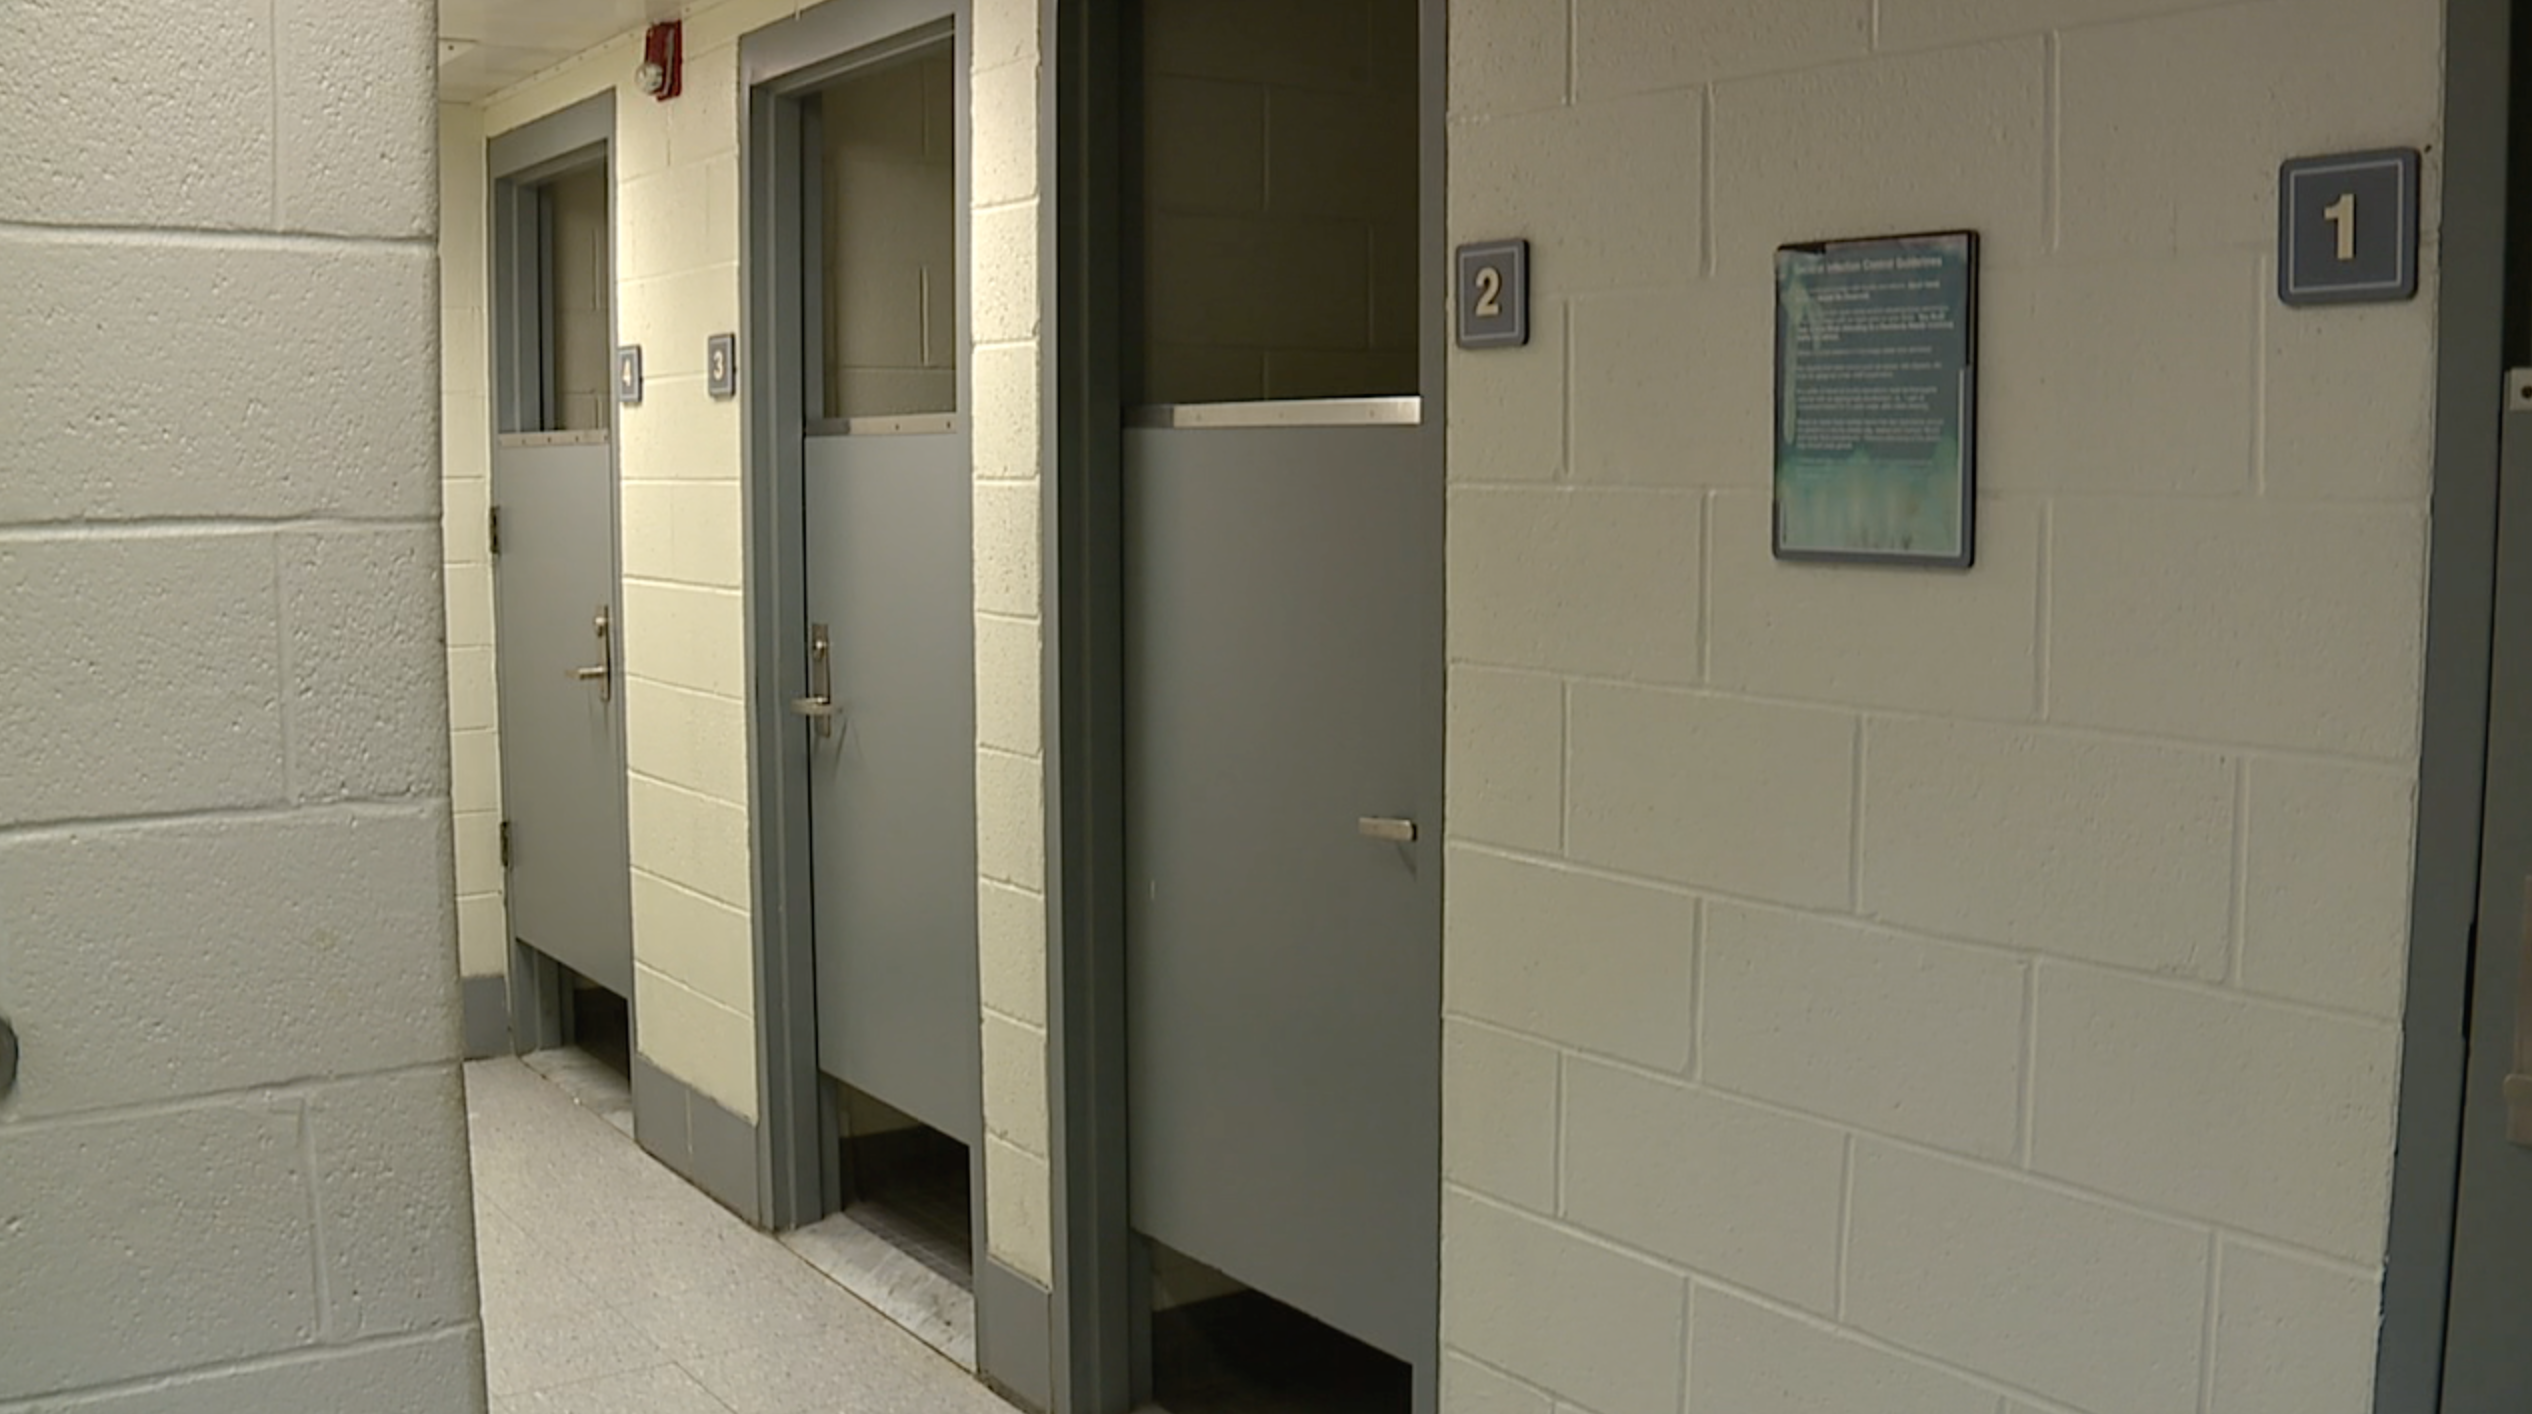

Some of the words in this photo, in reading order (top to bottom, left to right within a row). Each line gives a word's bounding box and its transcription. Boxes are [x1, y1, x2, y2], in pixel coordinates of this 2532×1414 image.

[2324, 193, 2355, 259] 1
[1863, 257, 1895, 271] Control
[1896, 255, 1943, 270] Guidelines
[1475, 266, 1500, 316] 2
[622, 358, 632, 387] 4
[712, 349, 724, 381] 3
